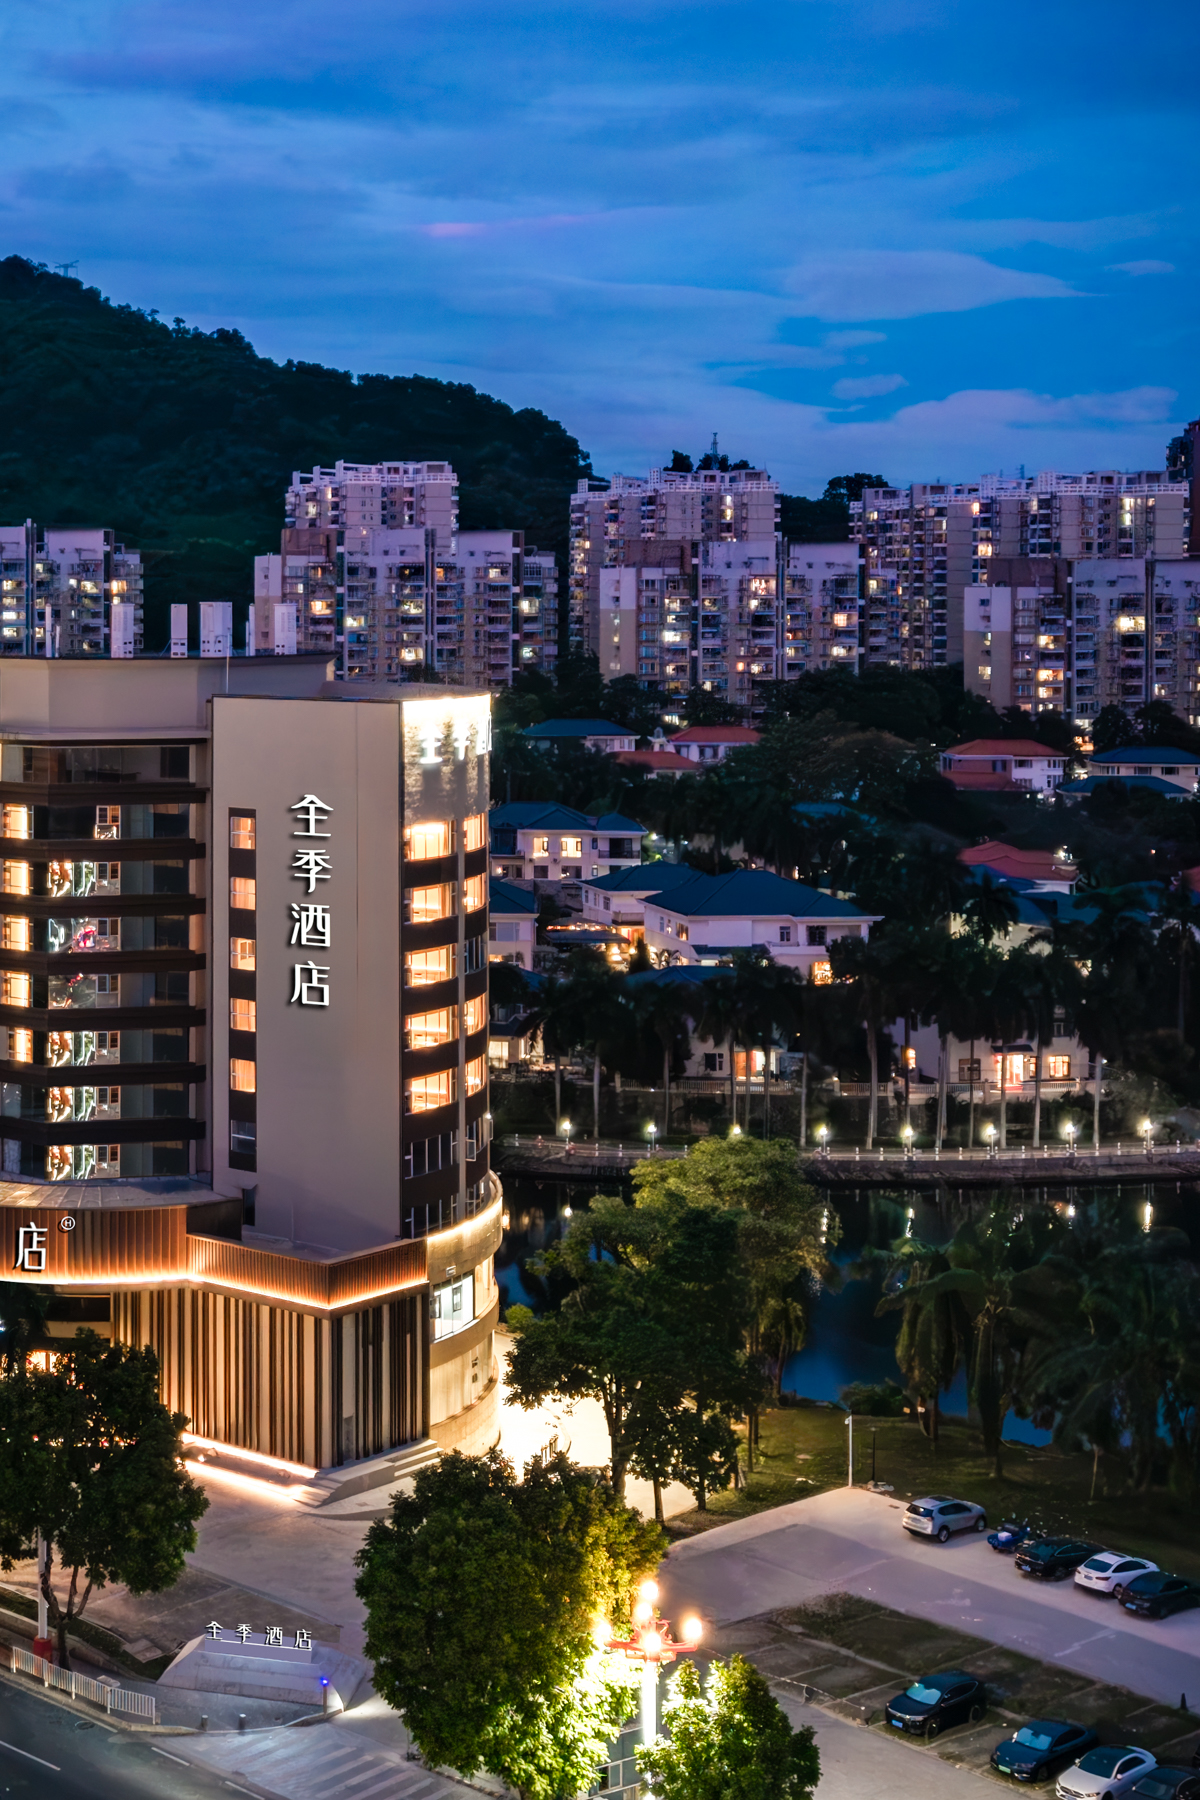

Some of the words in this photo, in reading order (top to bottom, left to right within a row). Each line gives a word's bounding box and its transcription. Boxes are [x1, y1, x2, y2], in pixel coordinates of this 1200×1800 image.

[290, 794, 334, 1007] 全季酒店
[205, 1620, 313, 1649] 全季酒店
